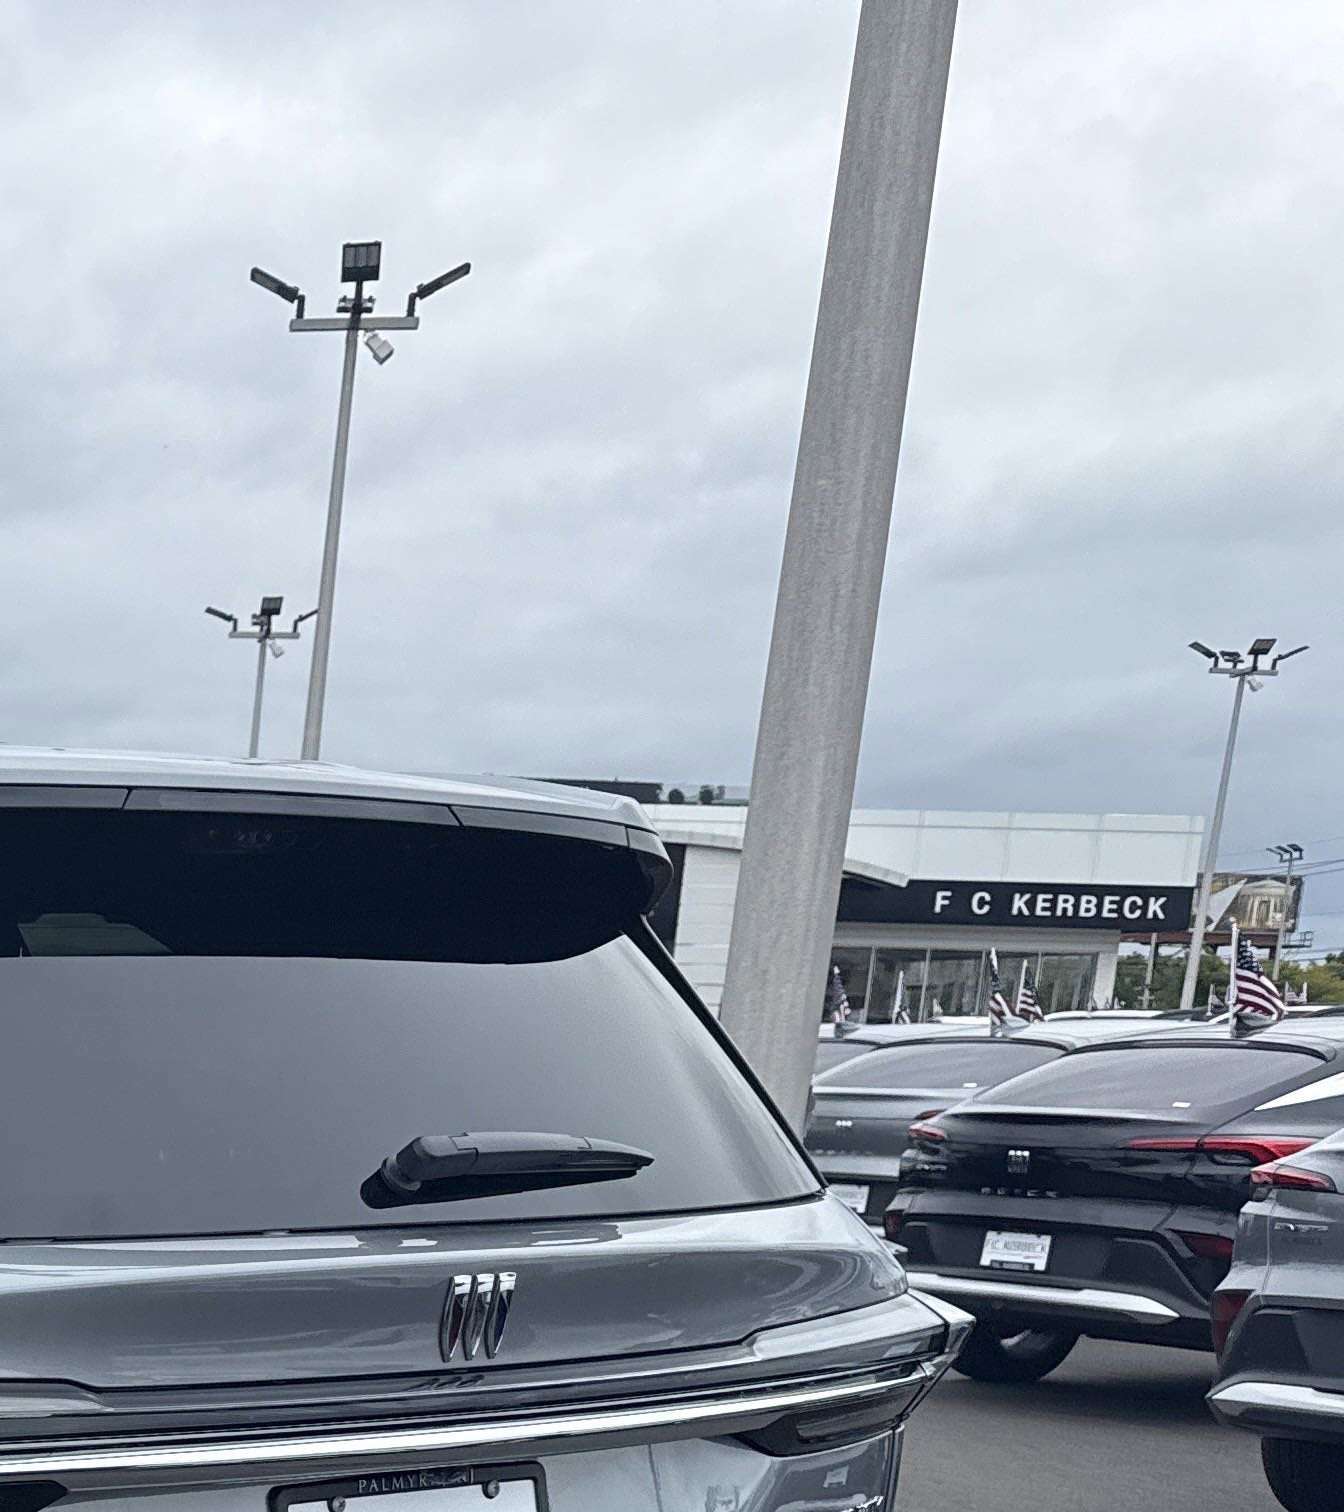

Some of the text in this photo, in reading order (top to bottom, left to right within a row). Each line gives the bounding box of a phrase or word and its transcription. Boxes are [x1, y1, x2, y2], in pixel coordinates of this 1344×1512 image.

[934, 890, 1168, 921] F C KERBECK
